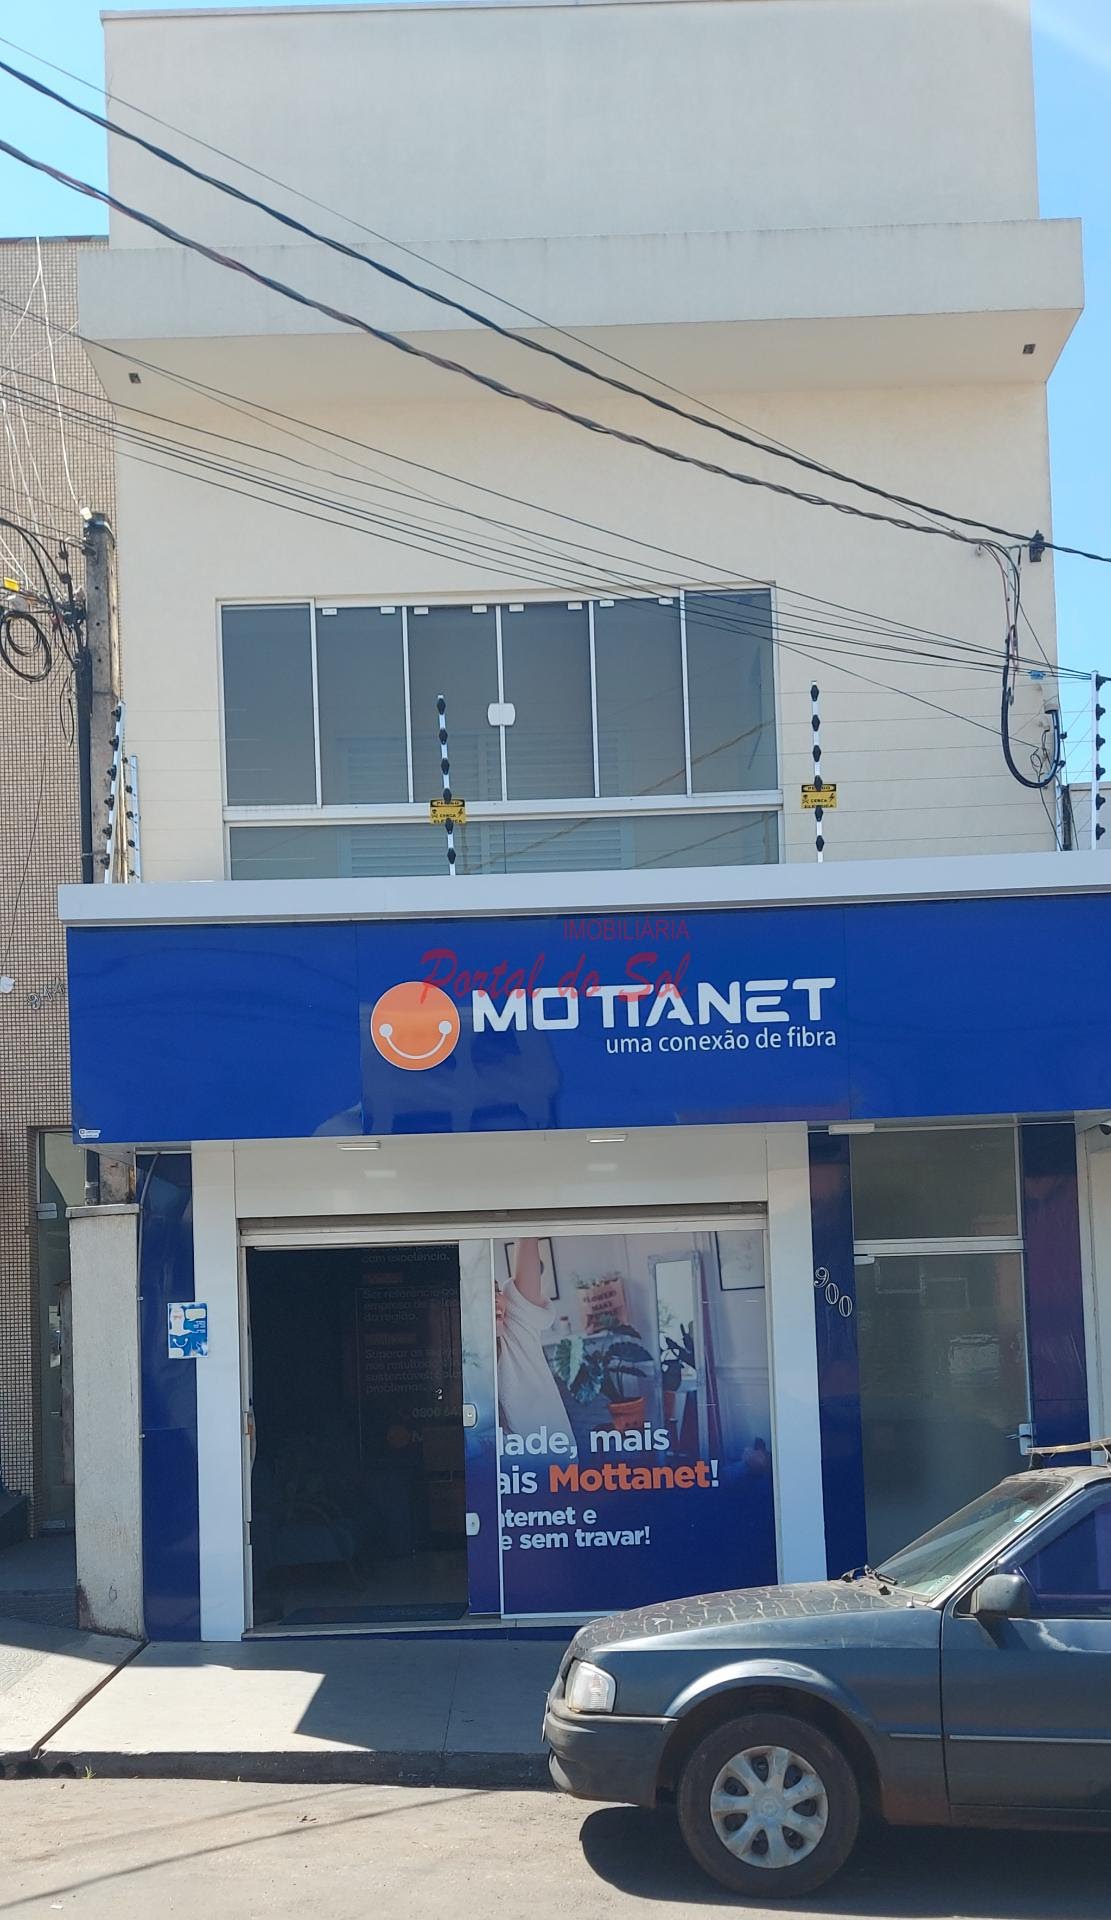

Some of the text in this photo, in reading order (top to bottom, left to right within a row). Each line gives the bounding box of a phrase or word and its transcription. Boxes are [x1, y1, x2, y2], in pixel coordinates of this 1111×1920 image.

[472, 977, 836, 1033] MOTTANET
[606, 1026, 837, 1054] uma conexão de fibra
[813, 1266, 853, 1318] 900
[590, 1422, 670, 1453] mais
[549, 1459, 719, 1493] Mottanet!
[582, 1508, 598, 1525] e
[519, 1532, 569, 1549] sem
[574, 1525, 651, 1547] travar!
